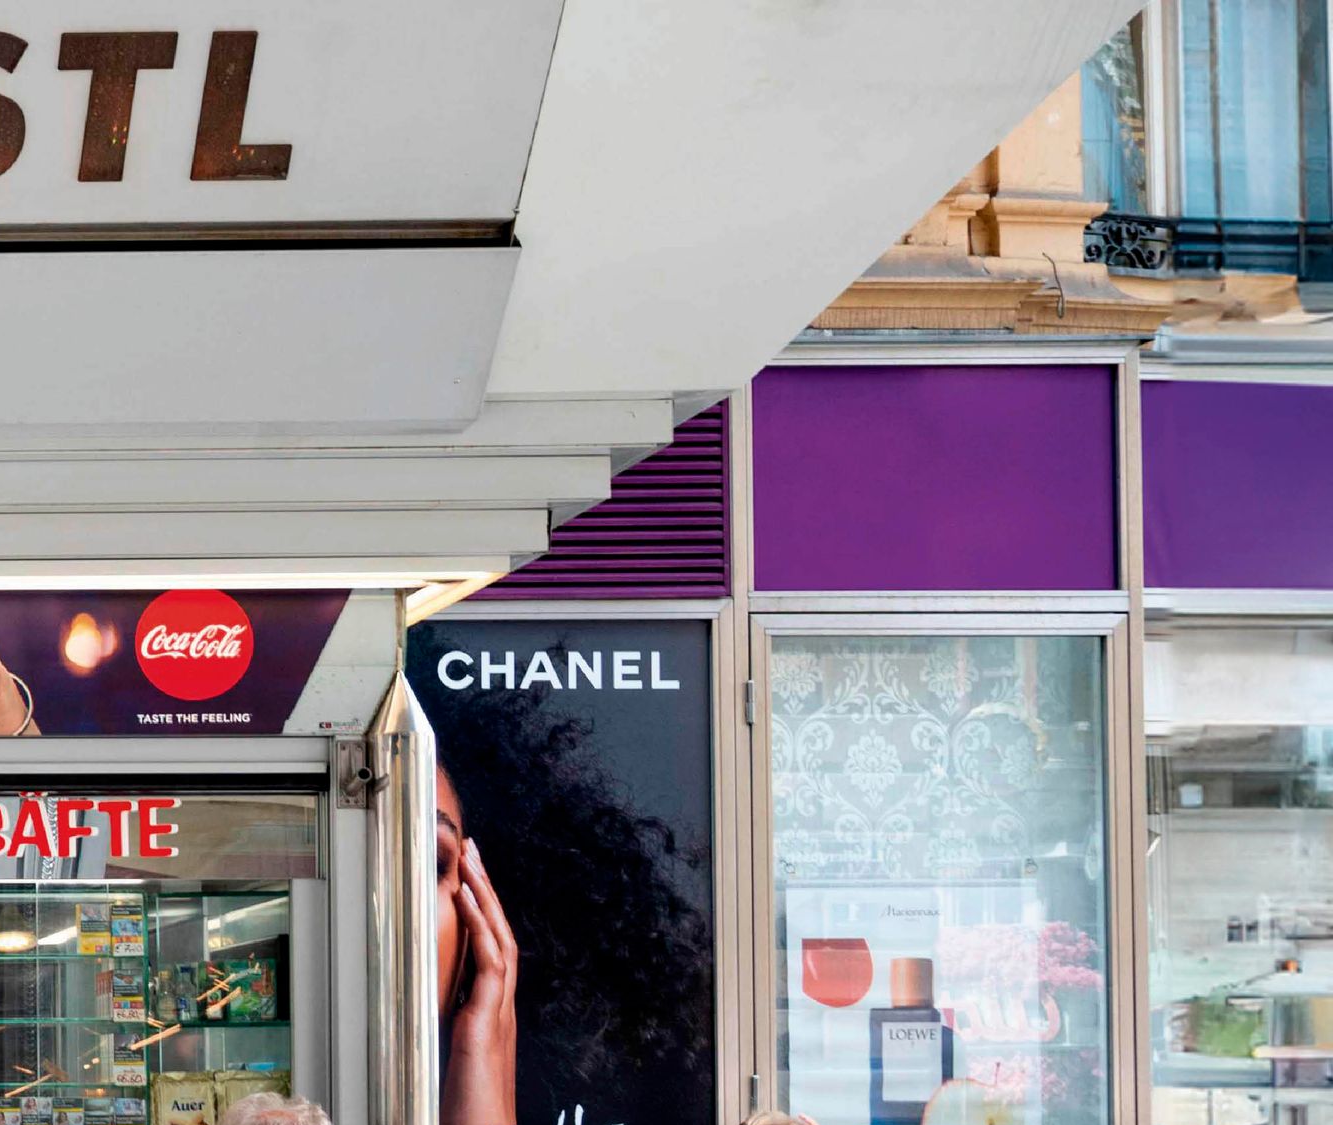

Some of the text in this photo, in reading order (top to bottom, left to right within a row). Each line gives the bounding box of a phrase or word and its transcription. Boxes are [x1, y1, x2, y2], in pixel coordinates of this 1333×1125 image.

[141, 624, 248, 660] Coca-Cola
[437, 650, 680, 690] CHANEL
[137, 713, 251, 724] TASTE THE FEELING
[889, 1028, 937, 1041] LOEWE
[171, 1100, 205, 1112] Auer
